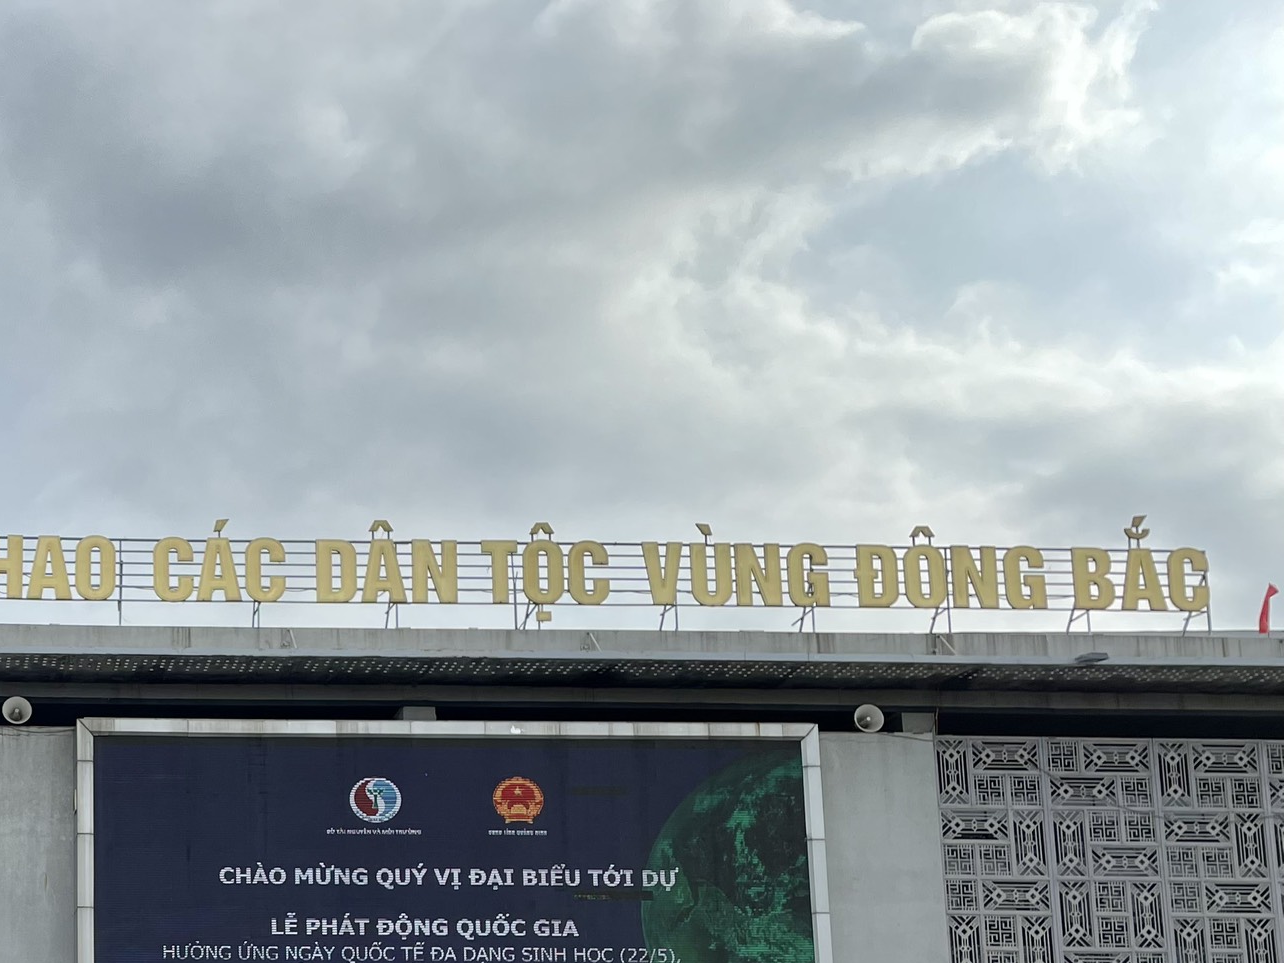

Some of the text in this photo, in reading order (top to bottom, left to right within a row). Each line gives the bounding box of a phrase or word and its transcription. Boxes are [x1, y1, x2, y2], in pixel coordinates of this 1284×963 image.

[153, 518, 285, 602] CÁC
[315, 519, 458, 605] DÂN
[481, 520, 611, 622] TỘC
[641, 522, 828, 609] VÙNG
[854, 525, 1049, 610] ĐÔNG
[1070, 514, 1210, 612] BẮC
[219, 862, 679, 891] CHÀO MỪNG QUÝ VỊ ĐẠI BIỂU TỚI DỰ
[270, 912, 580, 940] LỄ PHÁT ĐỘNG QUỐC GIA
[163, 941, 232, 960] HƯỞNG
[238, 941, 278, 960] ỨNG
[285, 941, 335, 960] NGÀY
[341, 942, 396, 963] QUỐC
[401, 942, 425, 961] TẾ
[430, 947, 457, 962] ĐA
[521, 947, 566, 963] SINH
